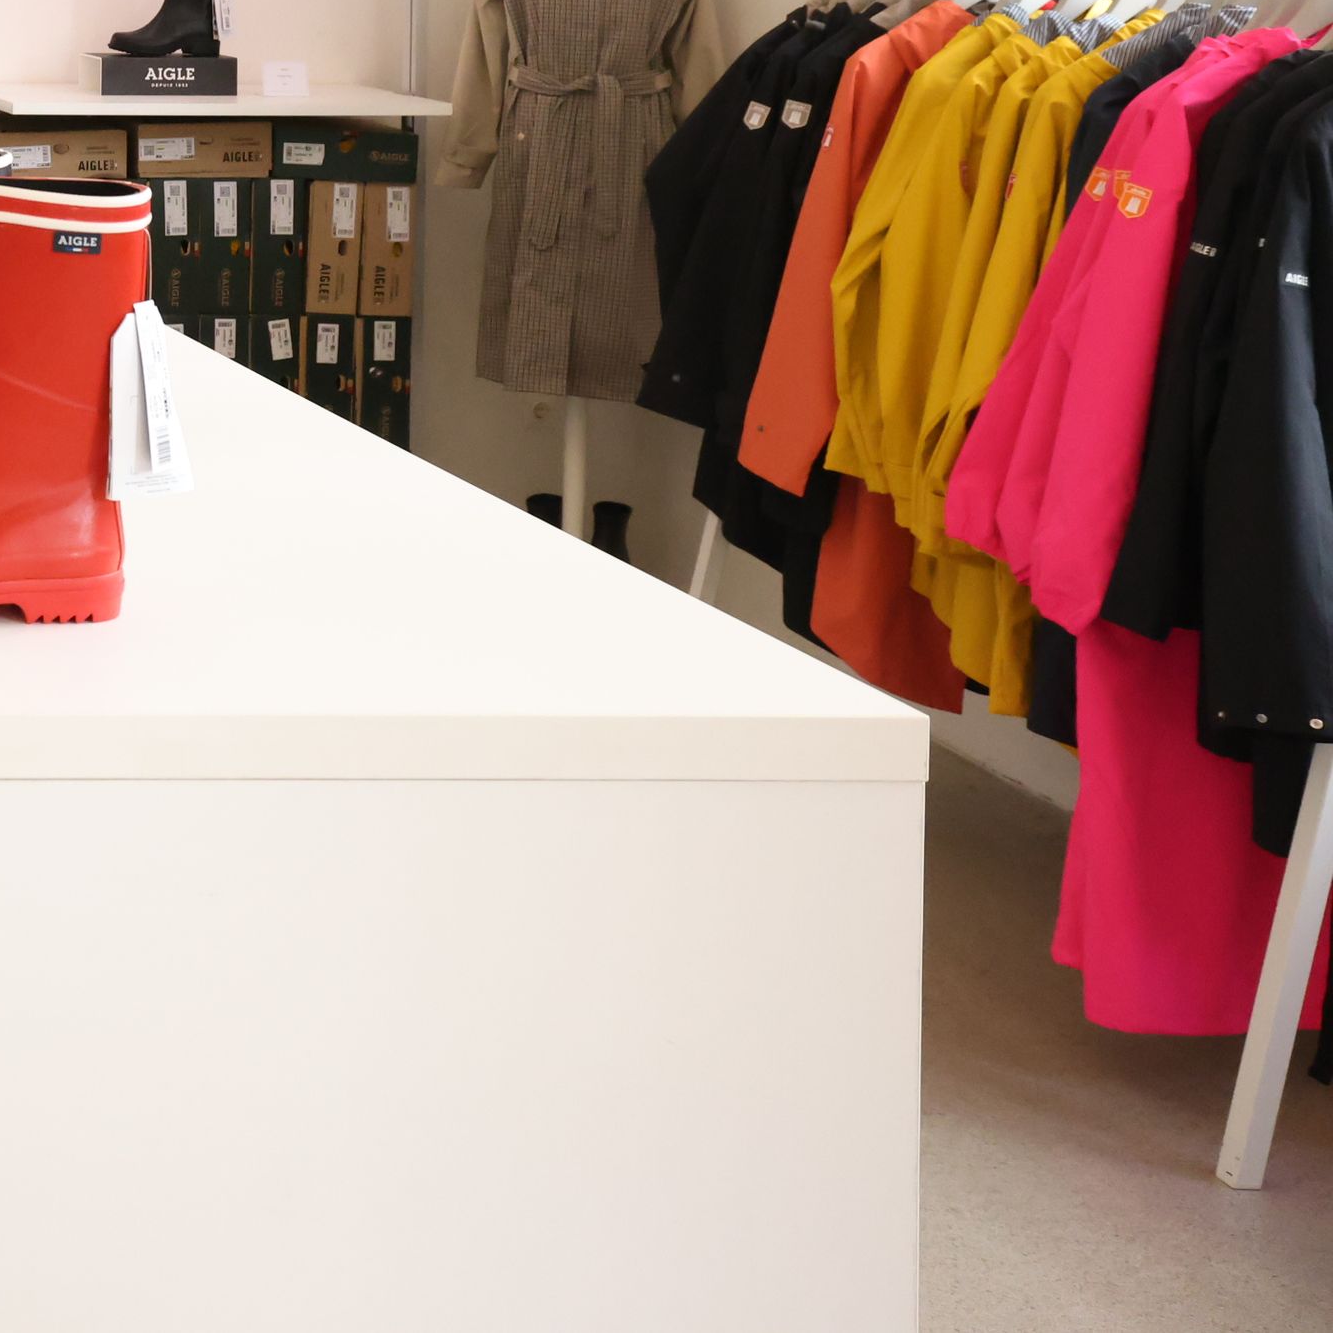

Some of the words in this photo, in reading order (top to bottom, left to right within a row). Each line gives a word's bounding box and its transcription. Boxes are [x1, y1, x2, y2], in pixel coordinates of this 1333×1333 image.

[145, 67, 195, 81] AIGLE
[223, 151, 254, 163] AIGLE
[78, 160, 109, 171] AIGLE
[57, 235, 98, 247] AIGLE
[319, 263, 331, 294] AIGLE
[373, 265, 386, 297] AIGLE
